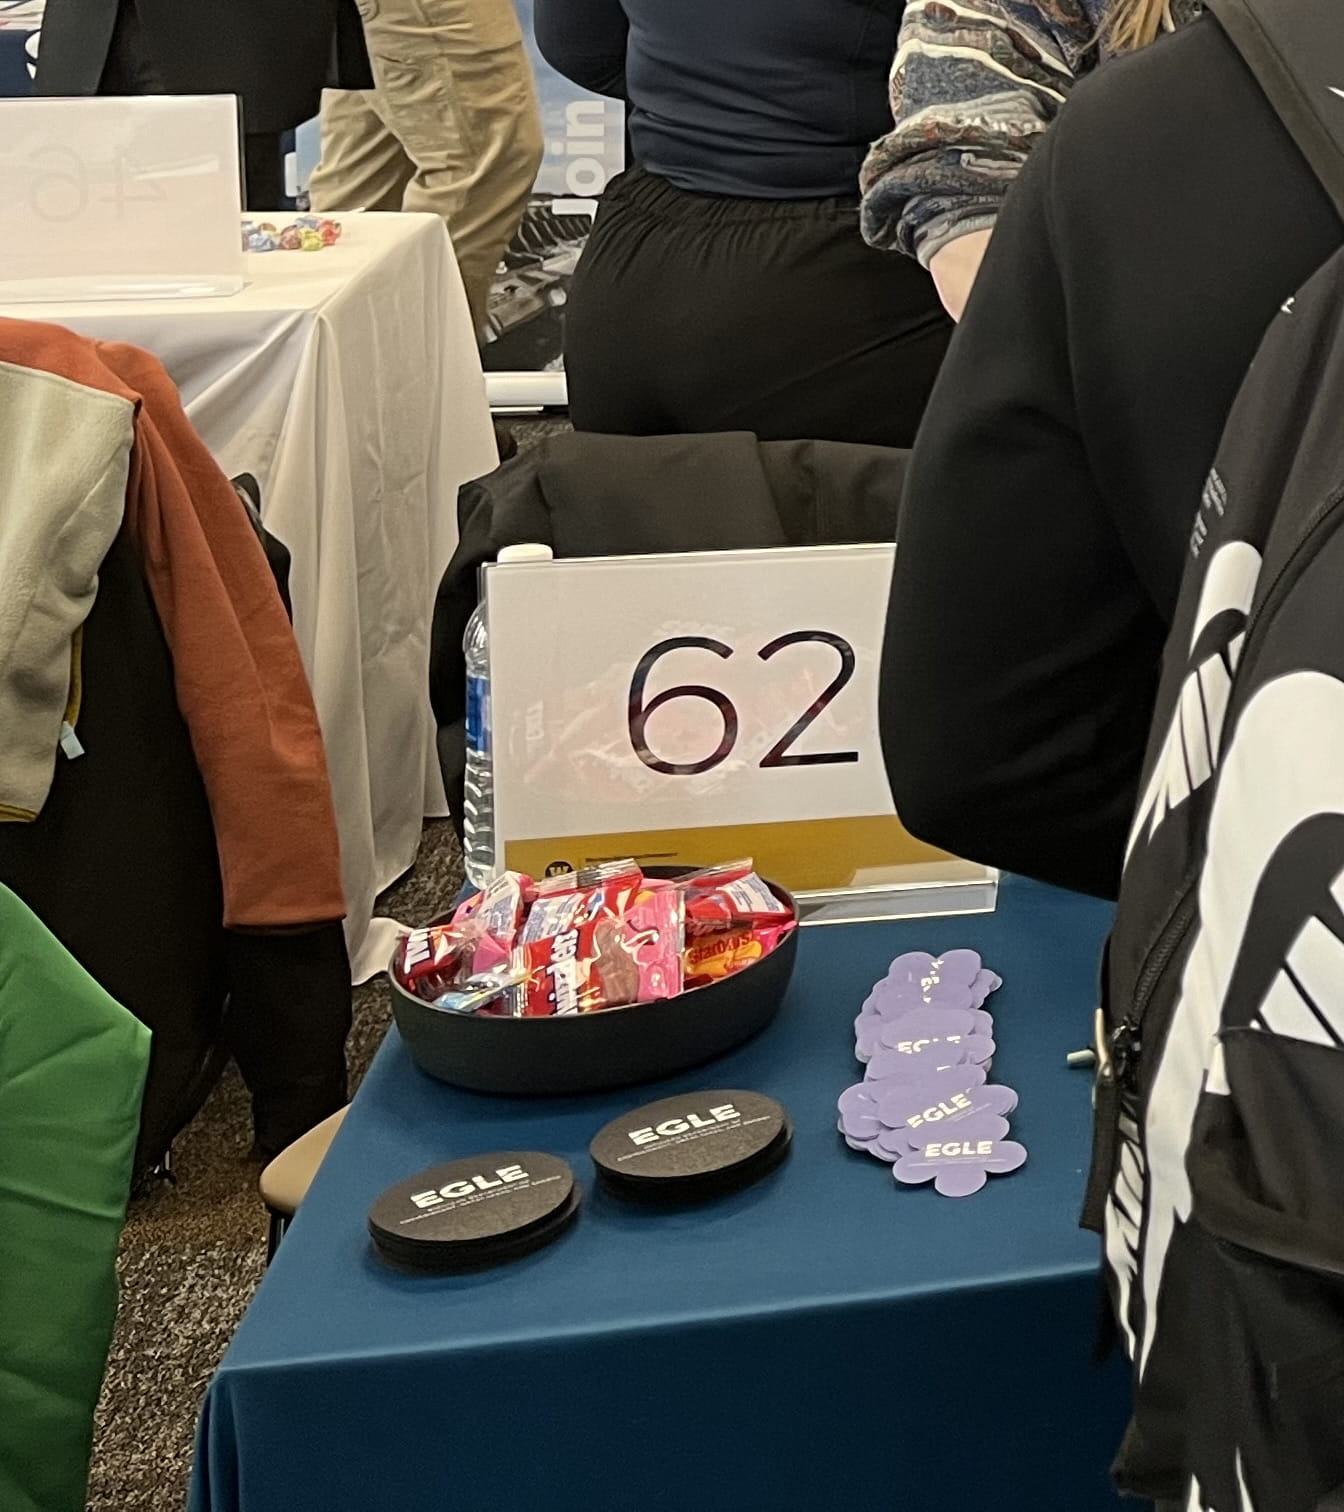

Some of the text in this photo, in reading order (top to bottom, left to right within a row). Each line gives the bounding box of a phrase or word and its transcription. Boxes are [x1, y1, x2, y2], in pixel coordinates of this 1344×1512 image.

[628, 630, 860, 776] 62
[628, 1104, 742, 1146] EGLE
[907, 1093, 972, 1128] EGLE
[924, 1141, 993, 1157] EGLE
[410, 1164, 529, 1210] EGLE
